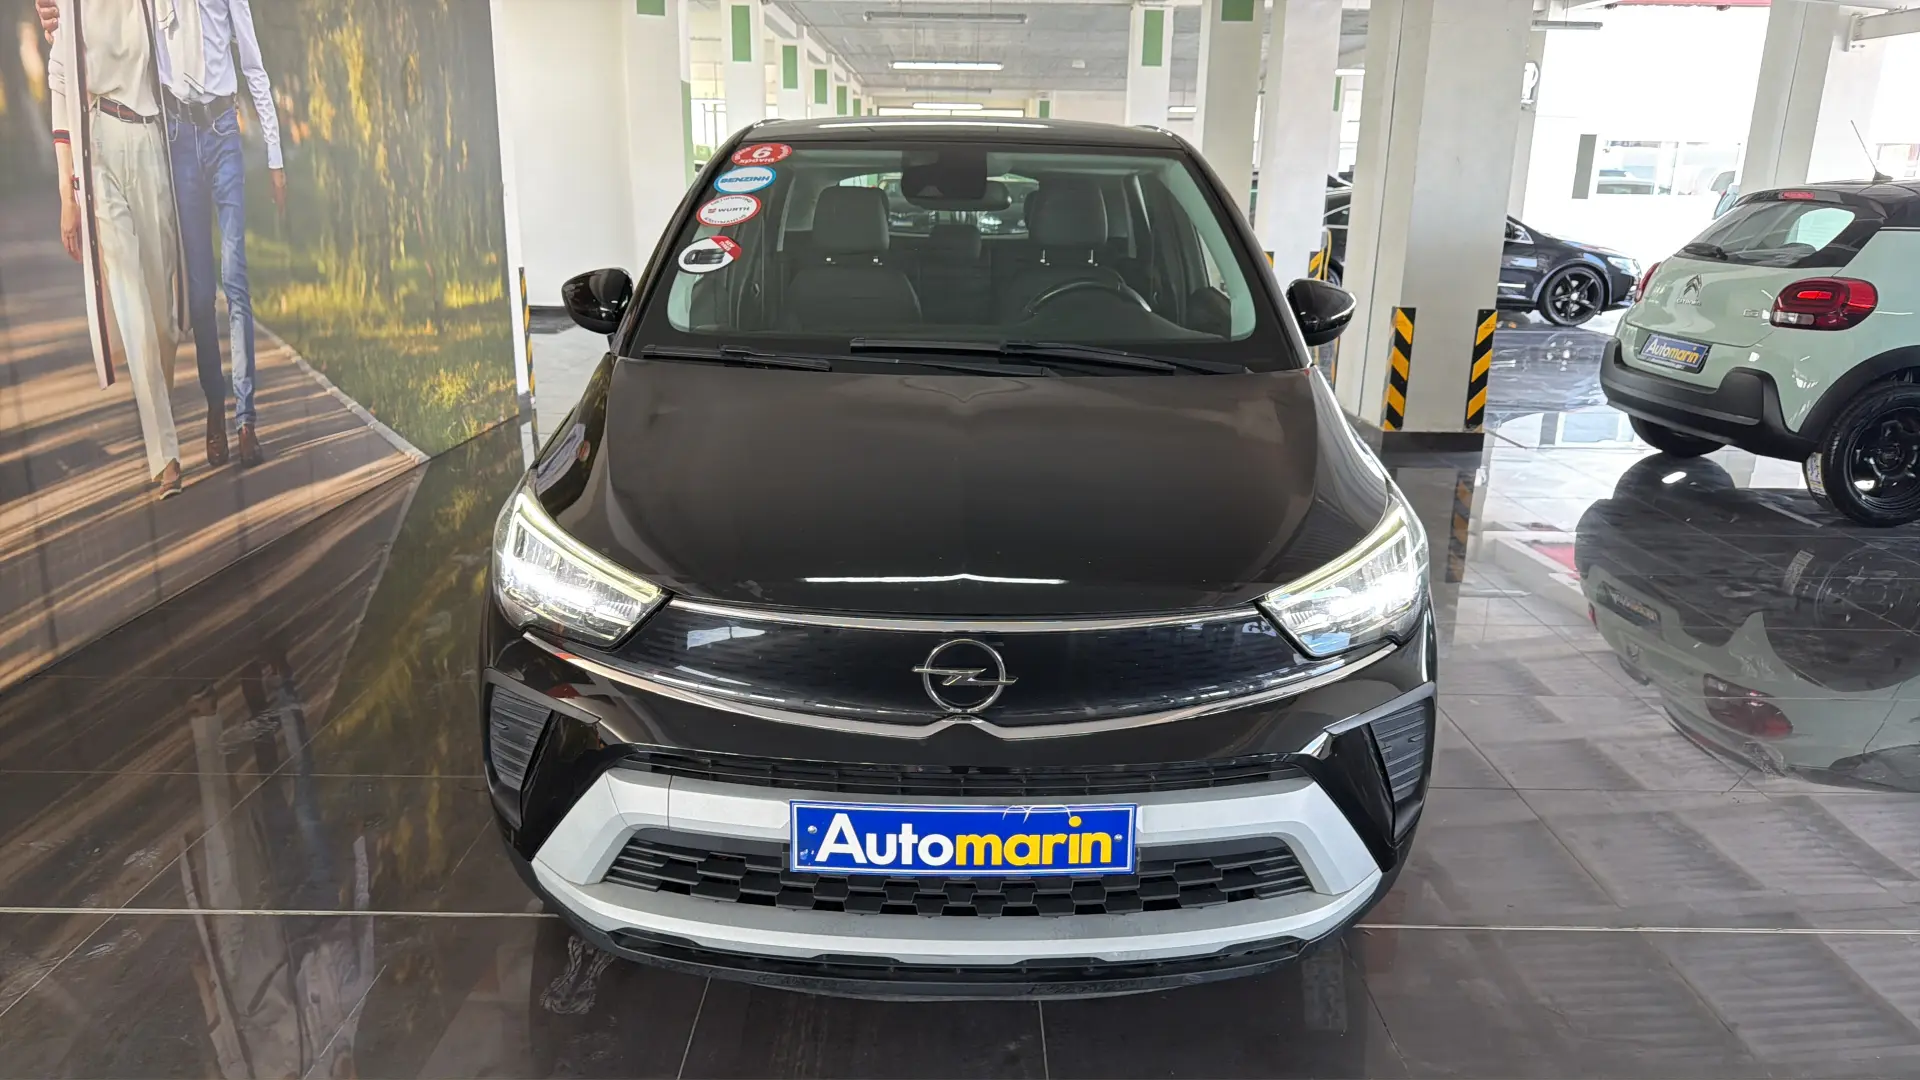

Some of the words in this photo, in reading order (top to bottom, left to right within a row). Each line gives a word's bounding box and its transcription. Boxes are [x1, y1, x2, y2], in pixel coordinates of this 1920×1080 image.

[752, 146, 773, 159] 6
[1645, 338, 1700, 364] Automarin
[814, 812, 1112, 867] Automarin
